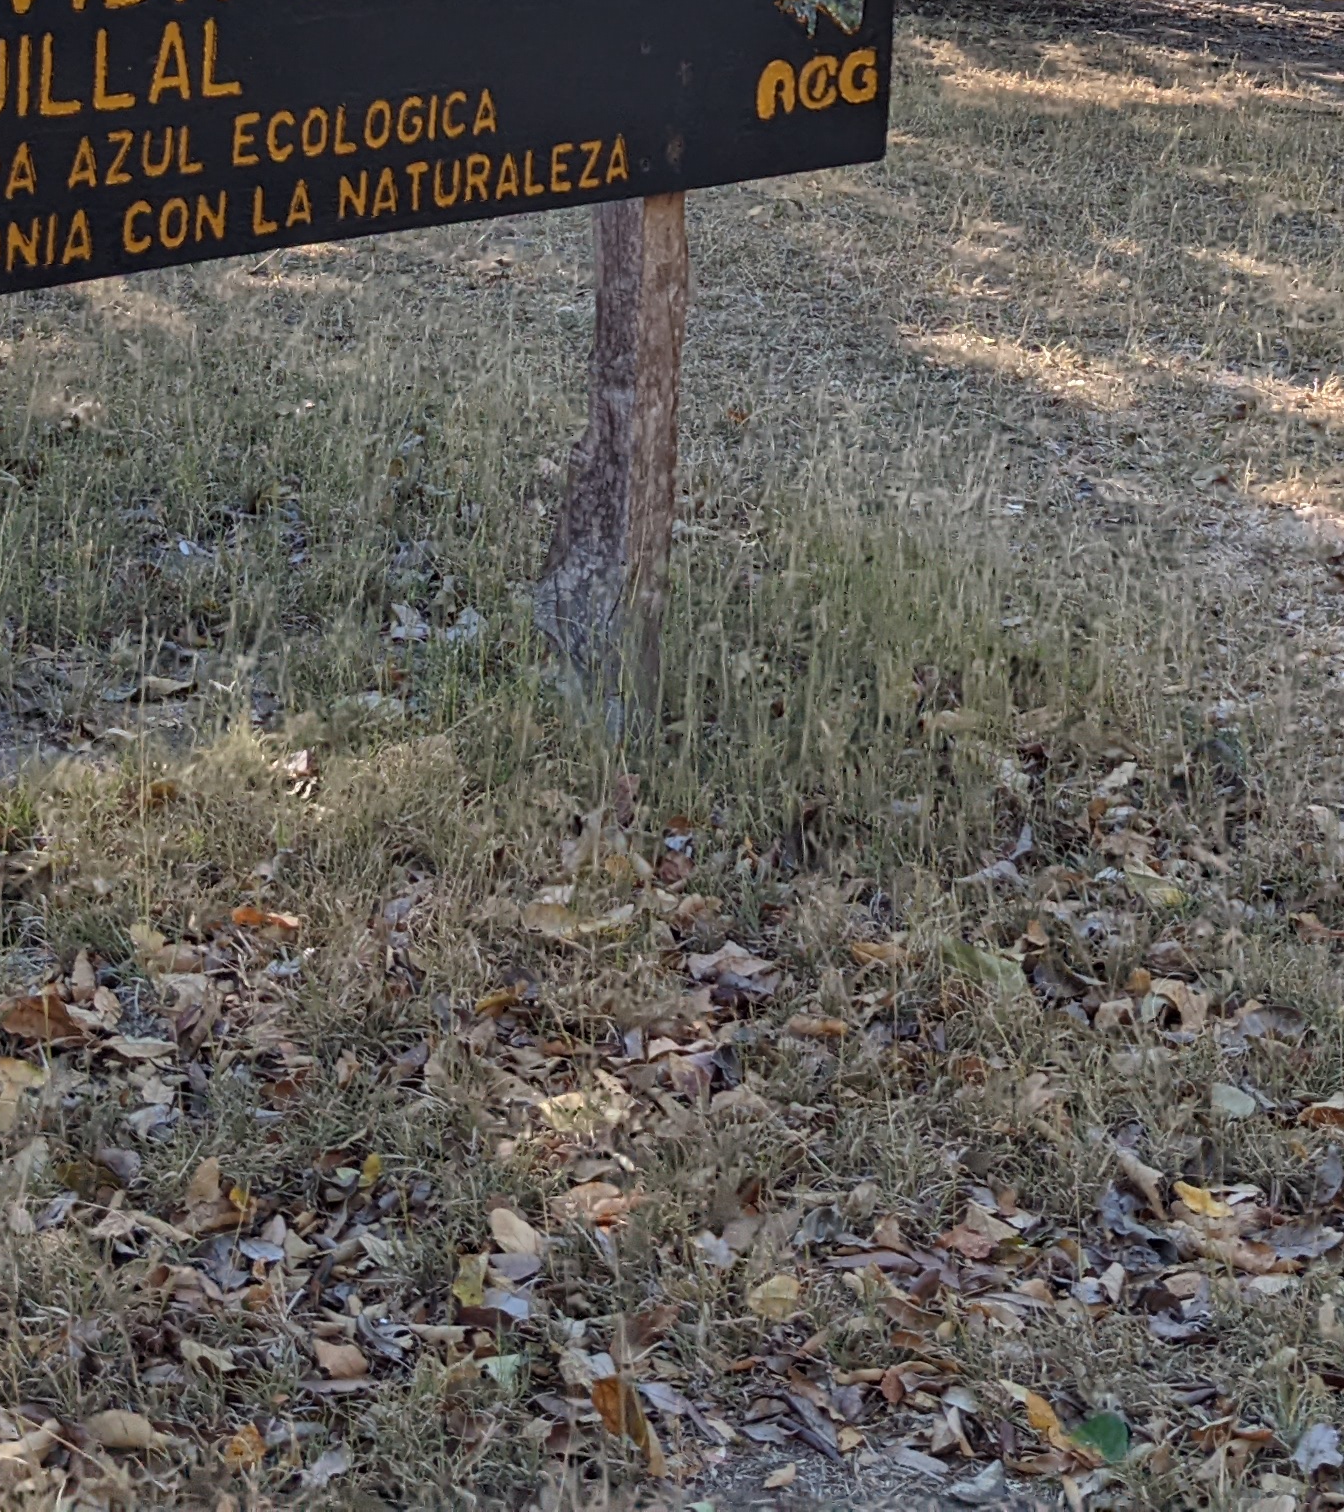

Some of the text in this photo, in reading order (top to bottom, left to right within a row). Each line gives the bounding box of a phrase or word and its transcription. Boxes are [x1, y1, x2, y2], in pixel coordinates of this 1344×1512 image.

[755, 48, 879, 121] ACG
[67, 127, 204, 188] AZUL
[231, 90, 497, 167] ECOLOGICA
[122, 193, 228, 255] CON
[251, 179, 312, 236] LA
[338, 137, 629, 218] NATURALEZA
